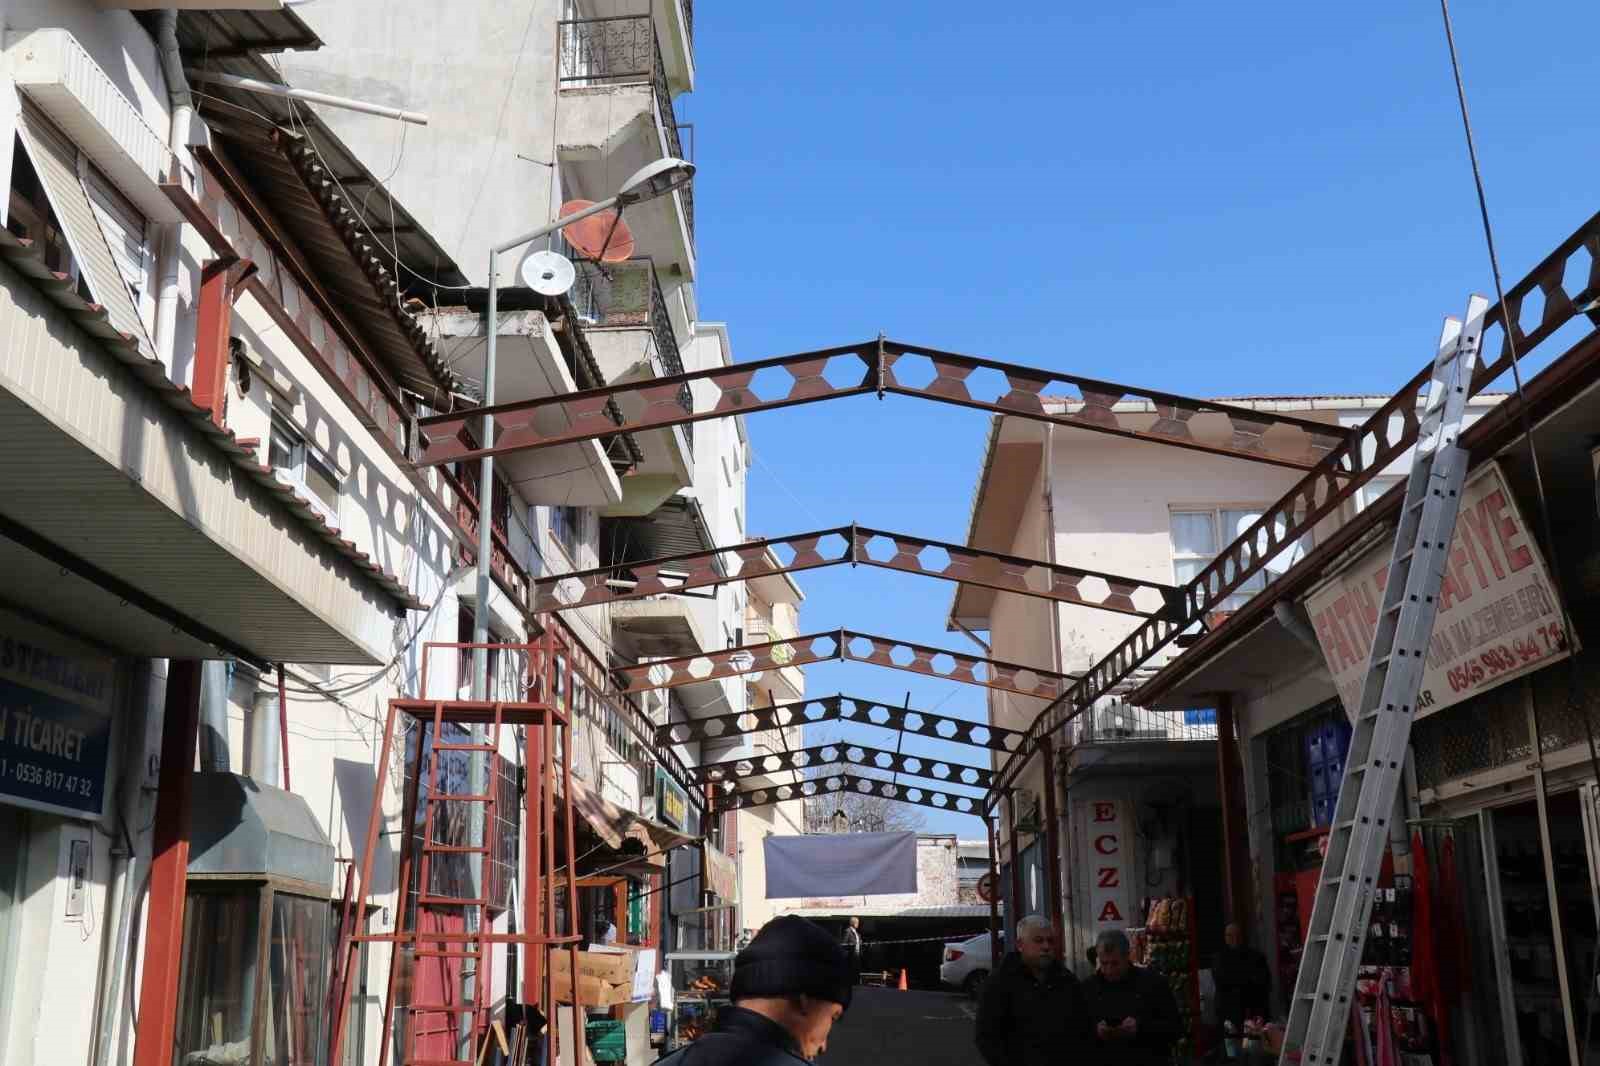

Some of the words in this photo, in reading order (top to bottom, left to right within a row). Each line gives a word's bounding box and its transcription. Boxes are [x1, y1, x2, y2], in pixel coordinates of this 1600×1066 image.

[13, 704, 85, 762] TİCARET
[16, 763, 43, 785] 0536
[44, 769, 64, 791] 817
